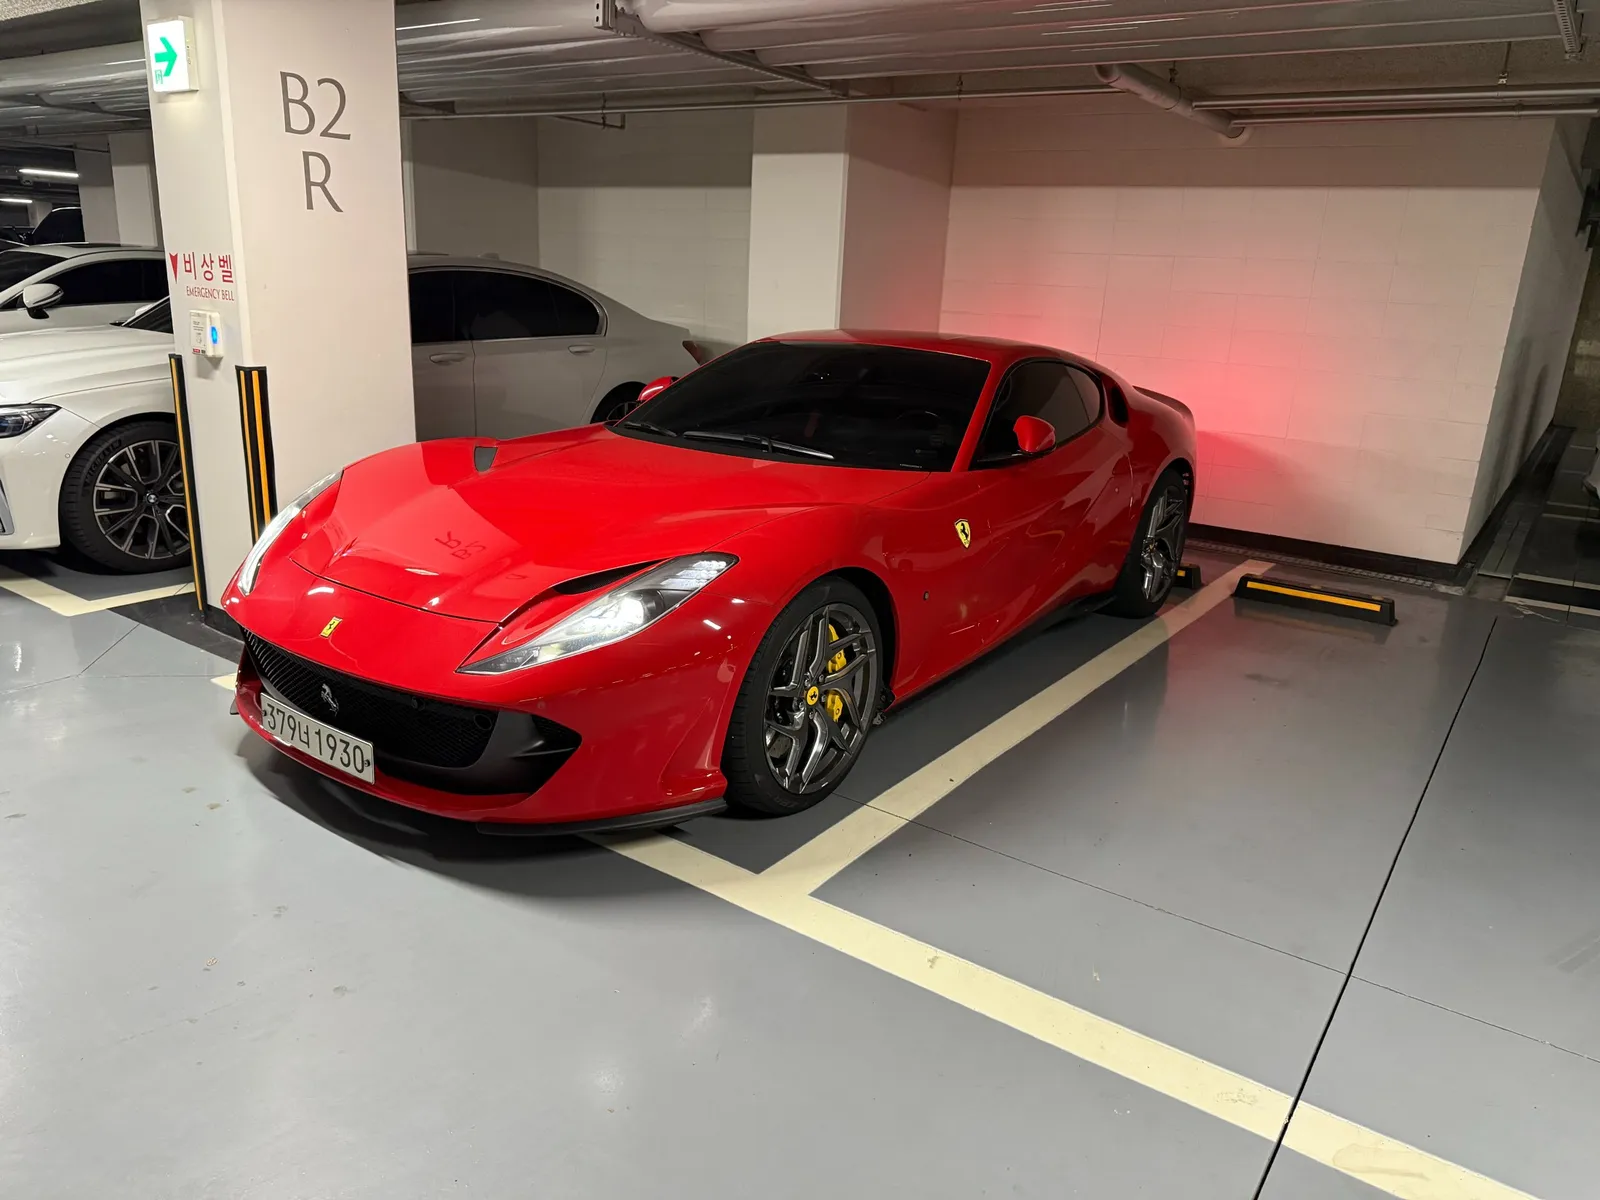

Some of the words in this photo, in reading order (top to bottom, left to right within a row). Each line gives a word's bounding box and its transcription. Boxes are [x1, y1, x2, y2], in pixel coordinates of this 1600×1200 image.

[279, 71, 351, 141] B2
[302, 151, 343, 213] R
[183, 252, 234, 283] 비상벨
[186, 286, 220, 299] EMERGENCY
[221, 290, 235, 301] BELL
